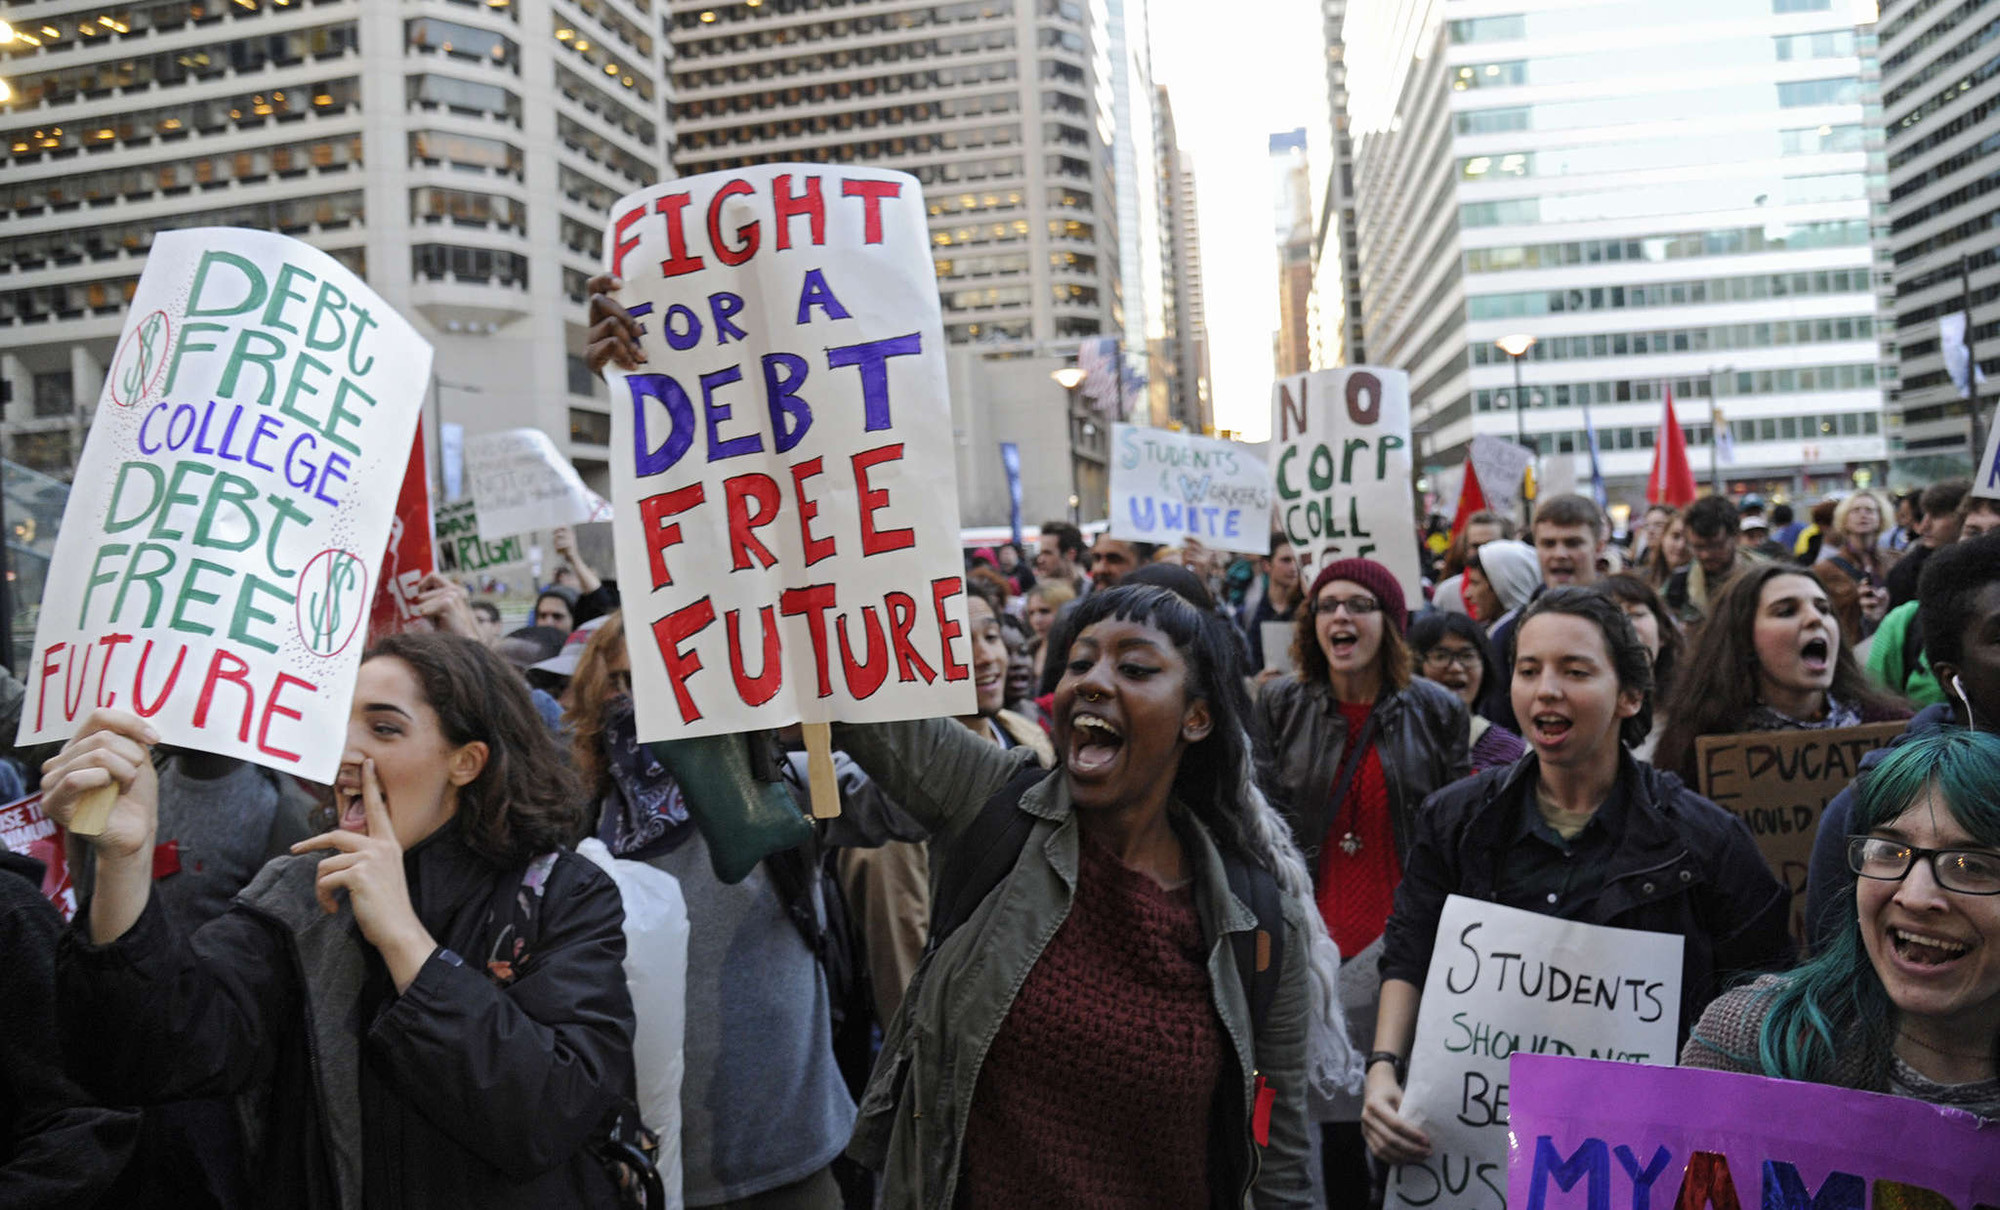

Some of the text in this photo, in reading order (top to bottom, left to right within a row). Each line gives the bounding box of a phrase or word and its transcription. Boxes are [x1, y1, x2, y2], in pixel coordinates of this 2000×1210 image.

[612, 173, 902, 279] FIGHT
[625, 268, 853, 364] FOR A
[164, 323, 377, 457] FREE
[626, 332, 922, 478] DEBT
[139, 401, 351, 506] COLLEGE
[1121, 427, 1240, 475] STUDENTS
[1178, 474, 1268, 510] WORKERS
[638, 443, 916, 593] FREE
[1129, 496, 1241, 538] UNITE
[1286, 496, 1371, 546] COLL
[79, 543, 297, 654] FREE
[651, 576, 970, 725] FUTURE
[35, 633, 318, 763] FUTURE
[1446, 922, 1664, 1023] STUDENTS
[1457, 1071, 1509, 1127] BE
